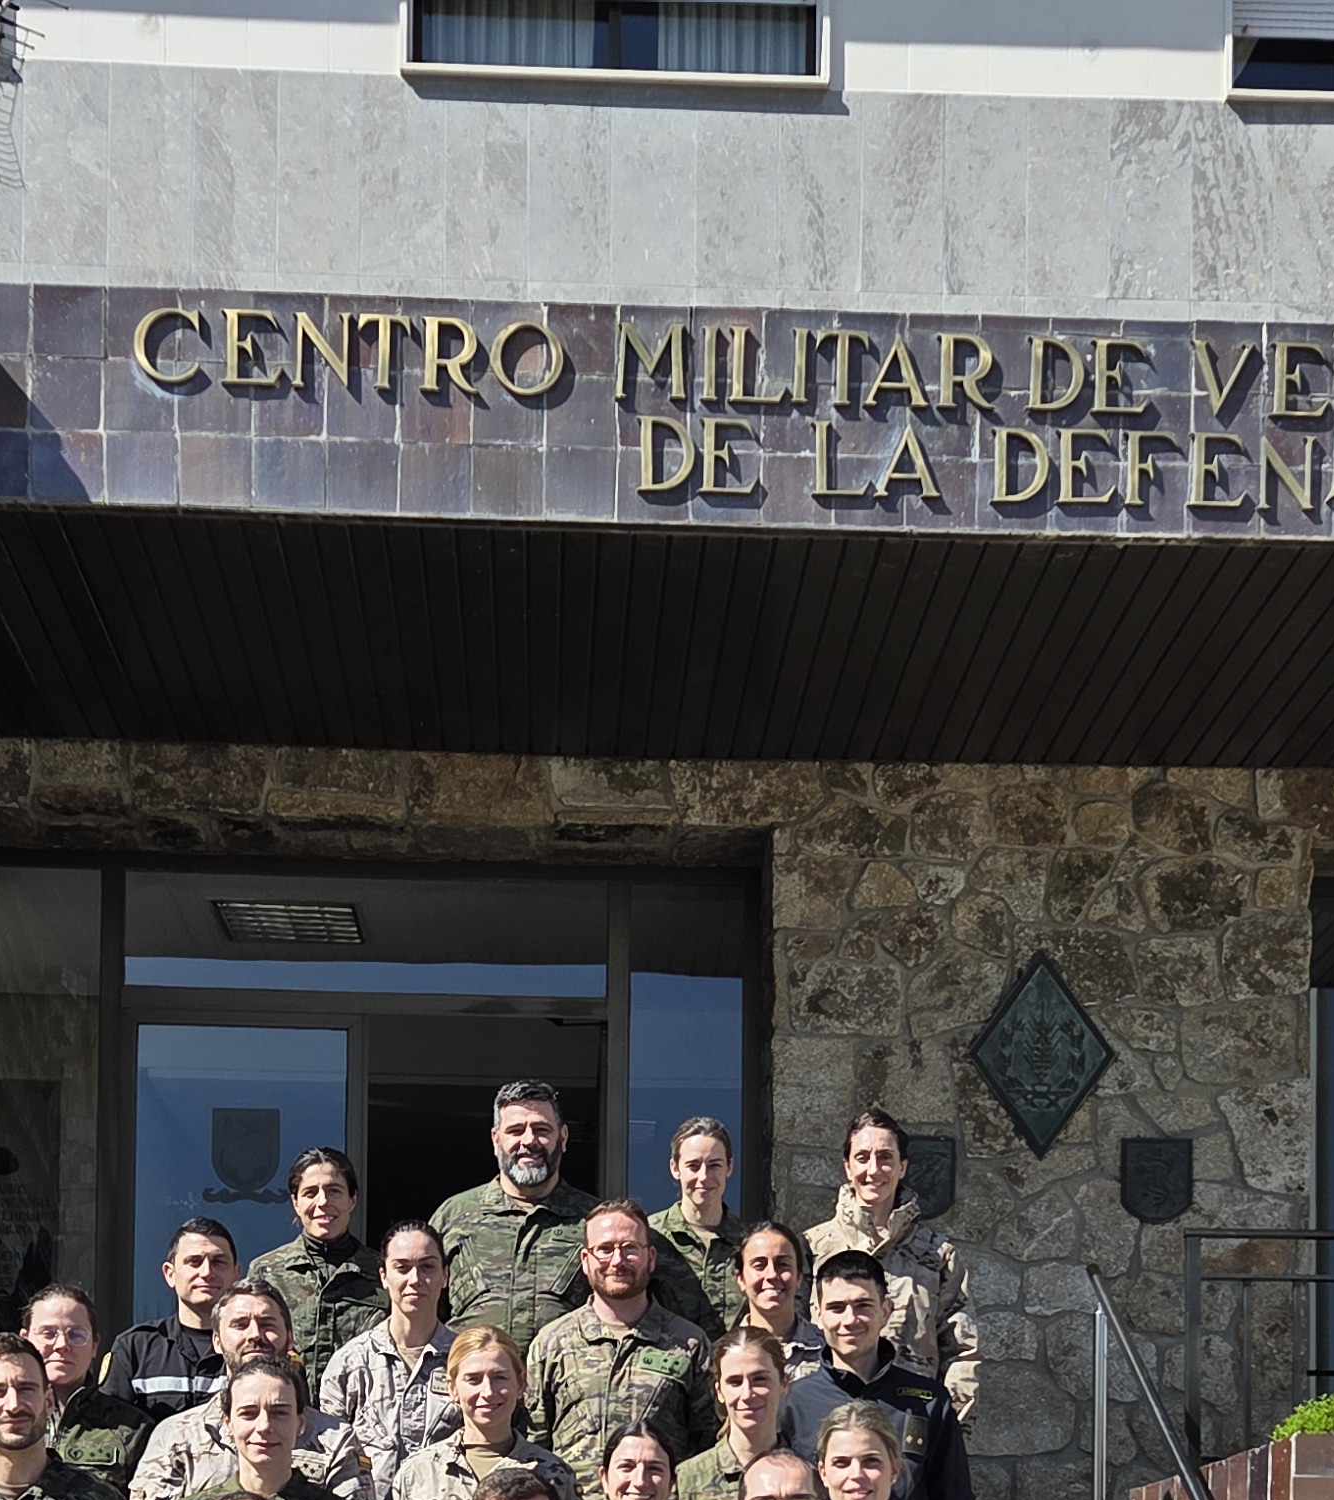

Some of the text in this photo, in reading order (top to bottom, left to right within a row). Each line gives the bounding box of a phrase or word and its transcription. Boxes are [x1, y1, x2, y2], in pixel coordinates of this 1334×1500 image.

[131, 307, 565, 396] CENTRO
[616, 323, 995, 411] MILITAR
[1028, 337, 1150, 414] DE
[638, 415, 759, 495] DE
[812, 421, 940, 500] LA
